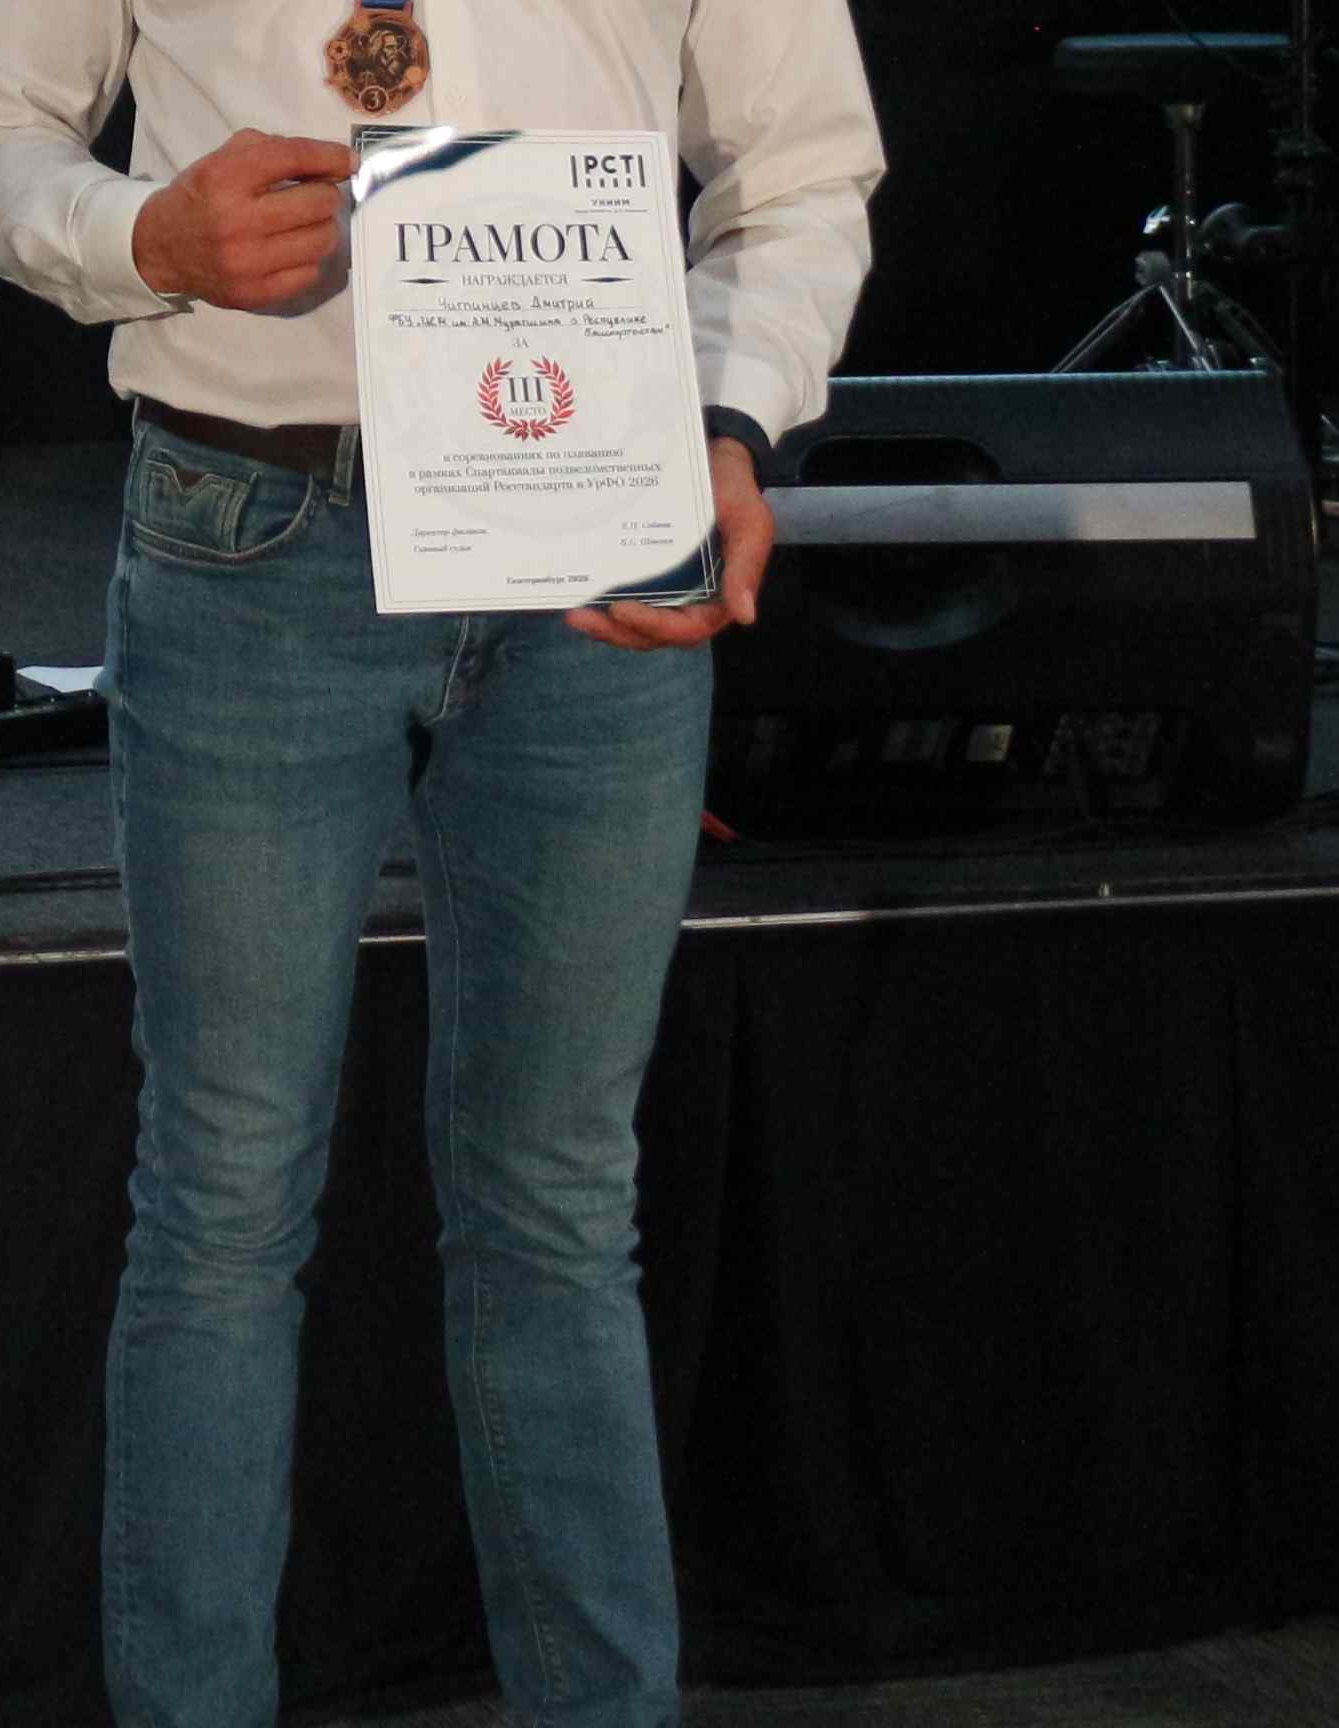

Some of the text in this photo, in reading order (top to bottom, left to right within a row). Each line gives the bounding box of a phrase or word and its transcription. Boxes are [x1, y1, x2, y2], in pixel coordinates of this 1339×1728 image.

[367, 90, 379, 109] 3
[394, 223, 633, 263] ГРАМОТА
[461, 273, 568, 287] НАГРАЖДАЕТСЯ
[530, 295, 595, 312] Дмитрий
[512, 337, 529, 349] ЗА
[509, 407, 548, 417] МЕСТО
[586, 477, 625, 492] УрФО
[628, 476, 660, 488] 2026
